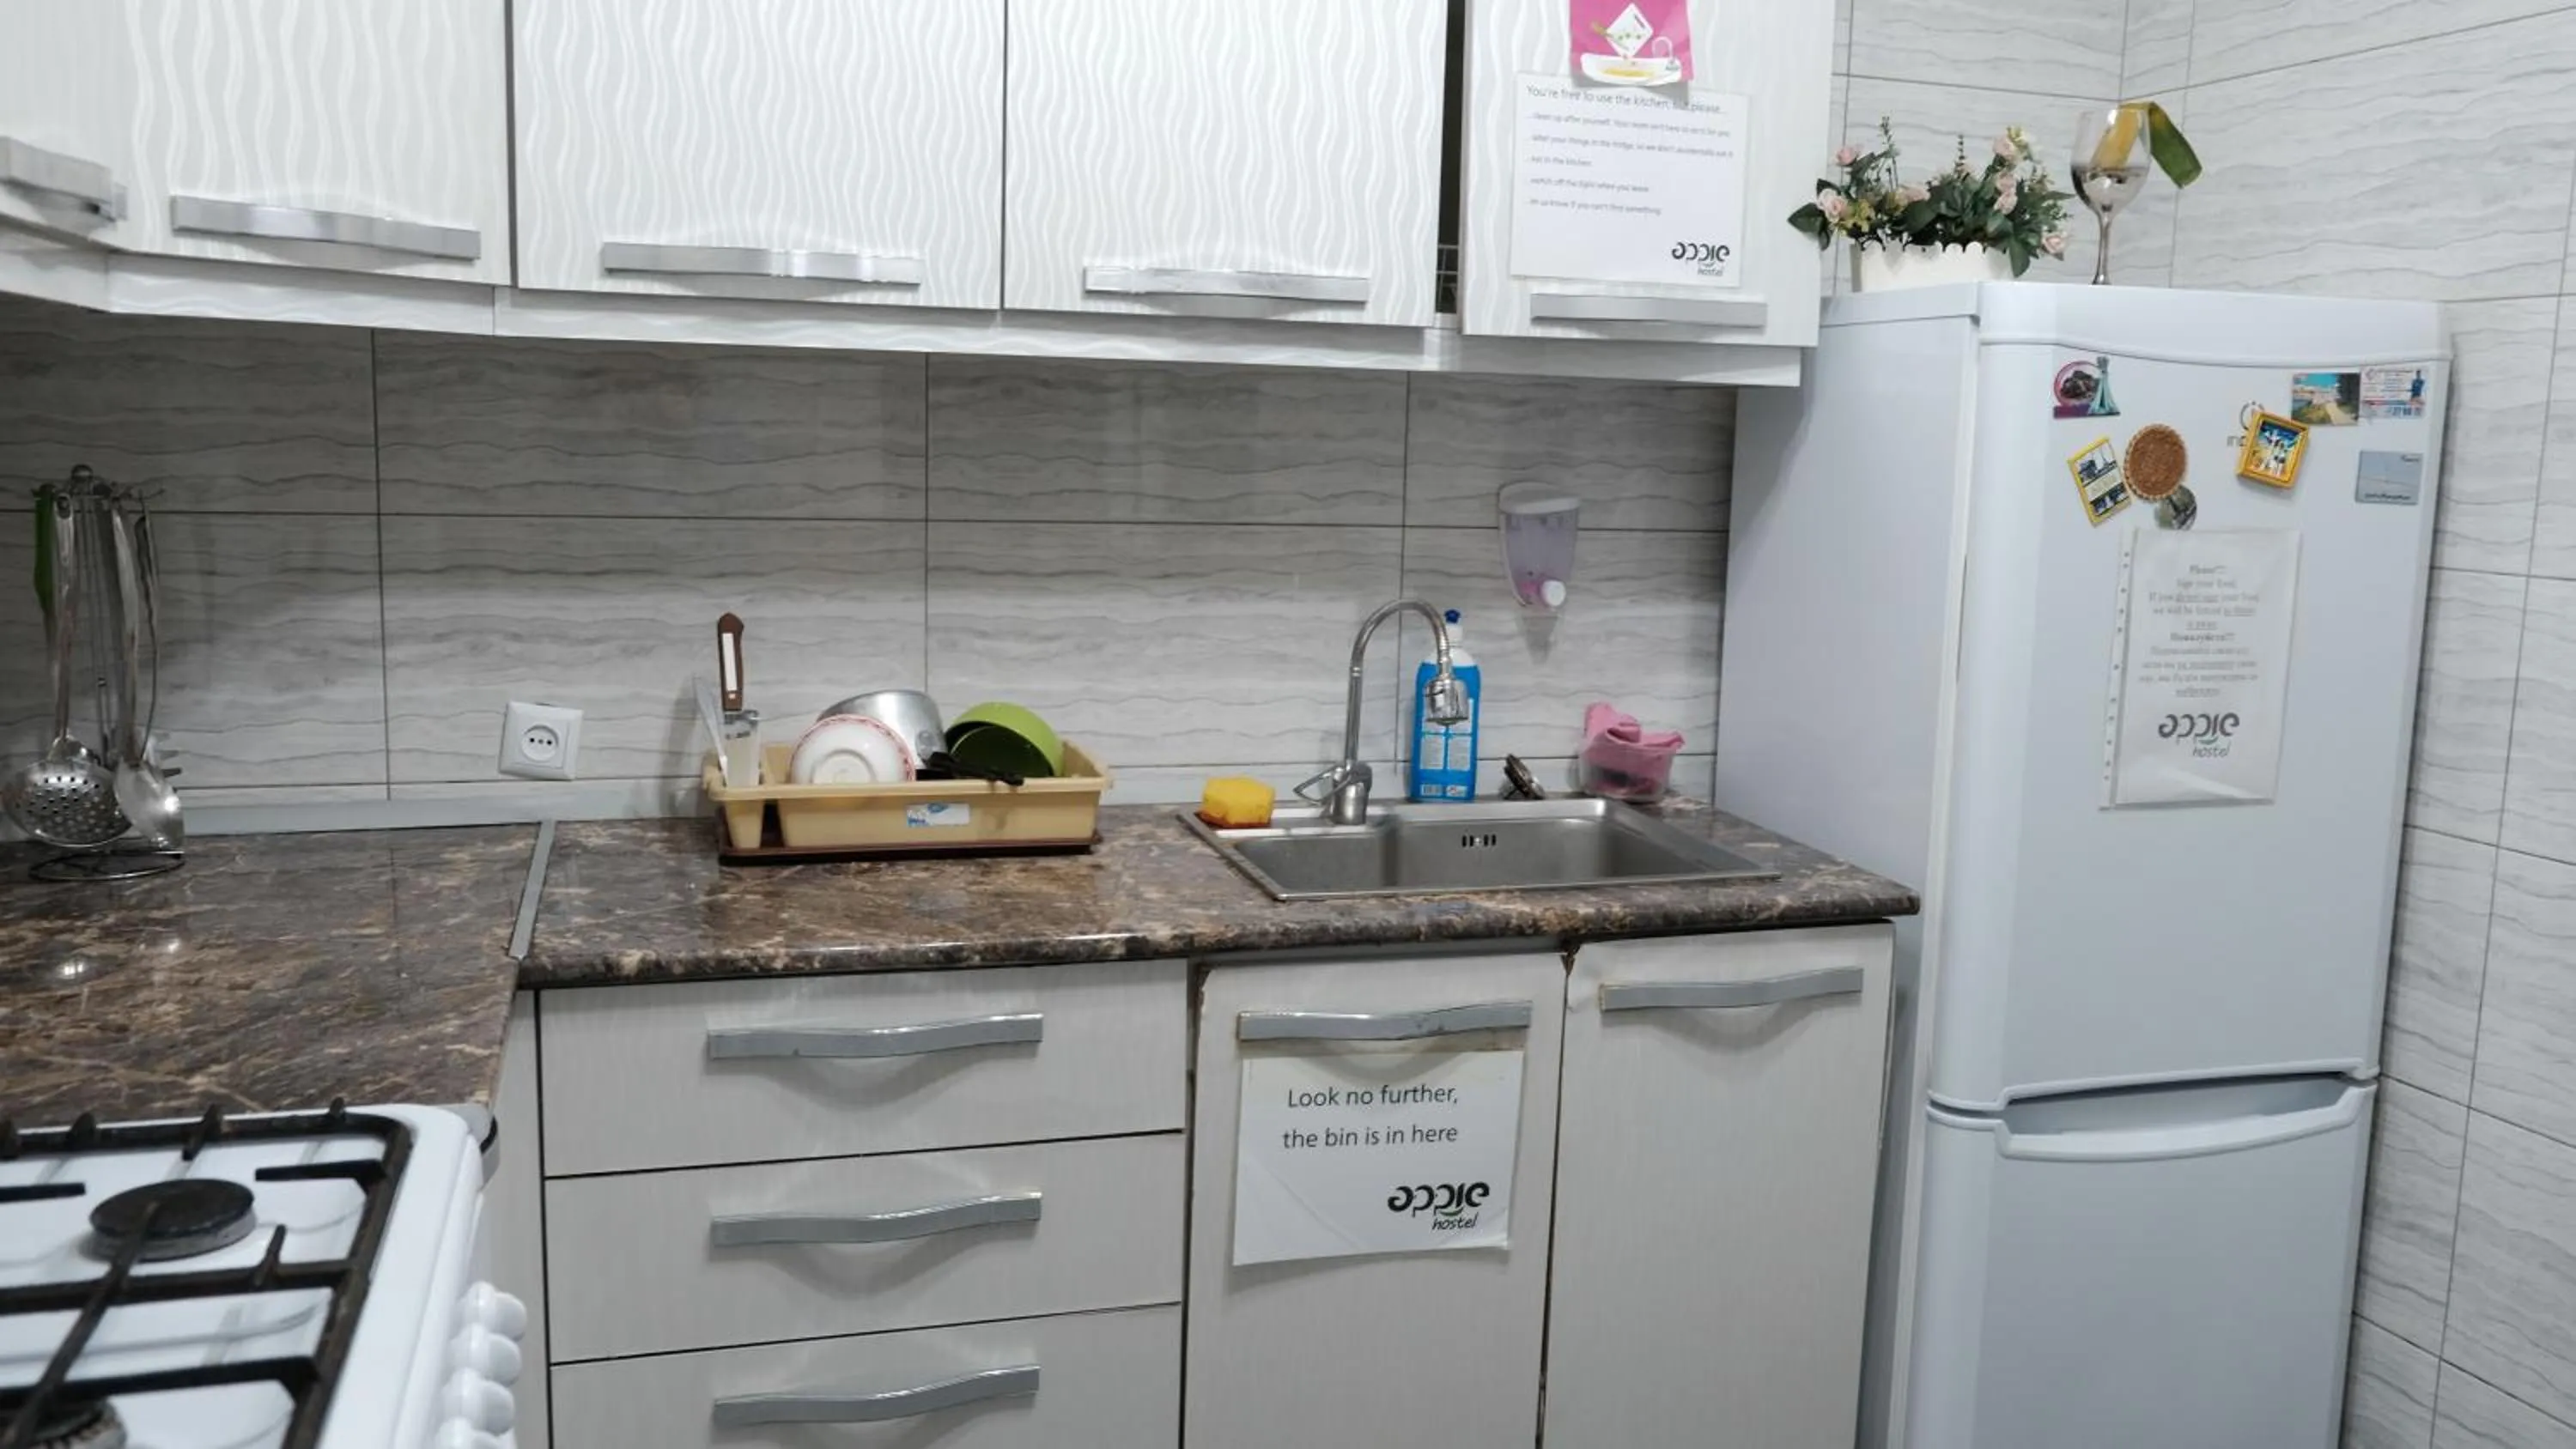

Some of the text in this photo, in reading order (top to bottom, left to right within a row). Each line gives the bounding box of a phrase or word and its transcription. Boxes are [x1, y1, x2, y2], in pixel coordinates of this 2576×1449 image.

[1526, 84, 1558, 99] You're
[1561, 88, 1581, 100] free
[1583, 90, 1595, 101] to
[1596, 94, 1613, 104] use
[1615, 94, 1631, 105] the
[2192, 743, 2231, 758] hostel
[1288, 1084, 1459, 1107] Look no further,
[1283, 1125, 1458, 1149] the bin is in here
[1432, 1212, 1479, 1230] hostel
